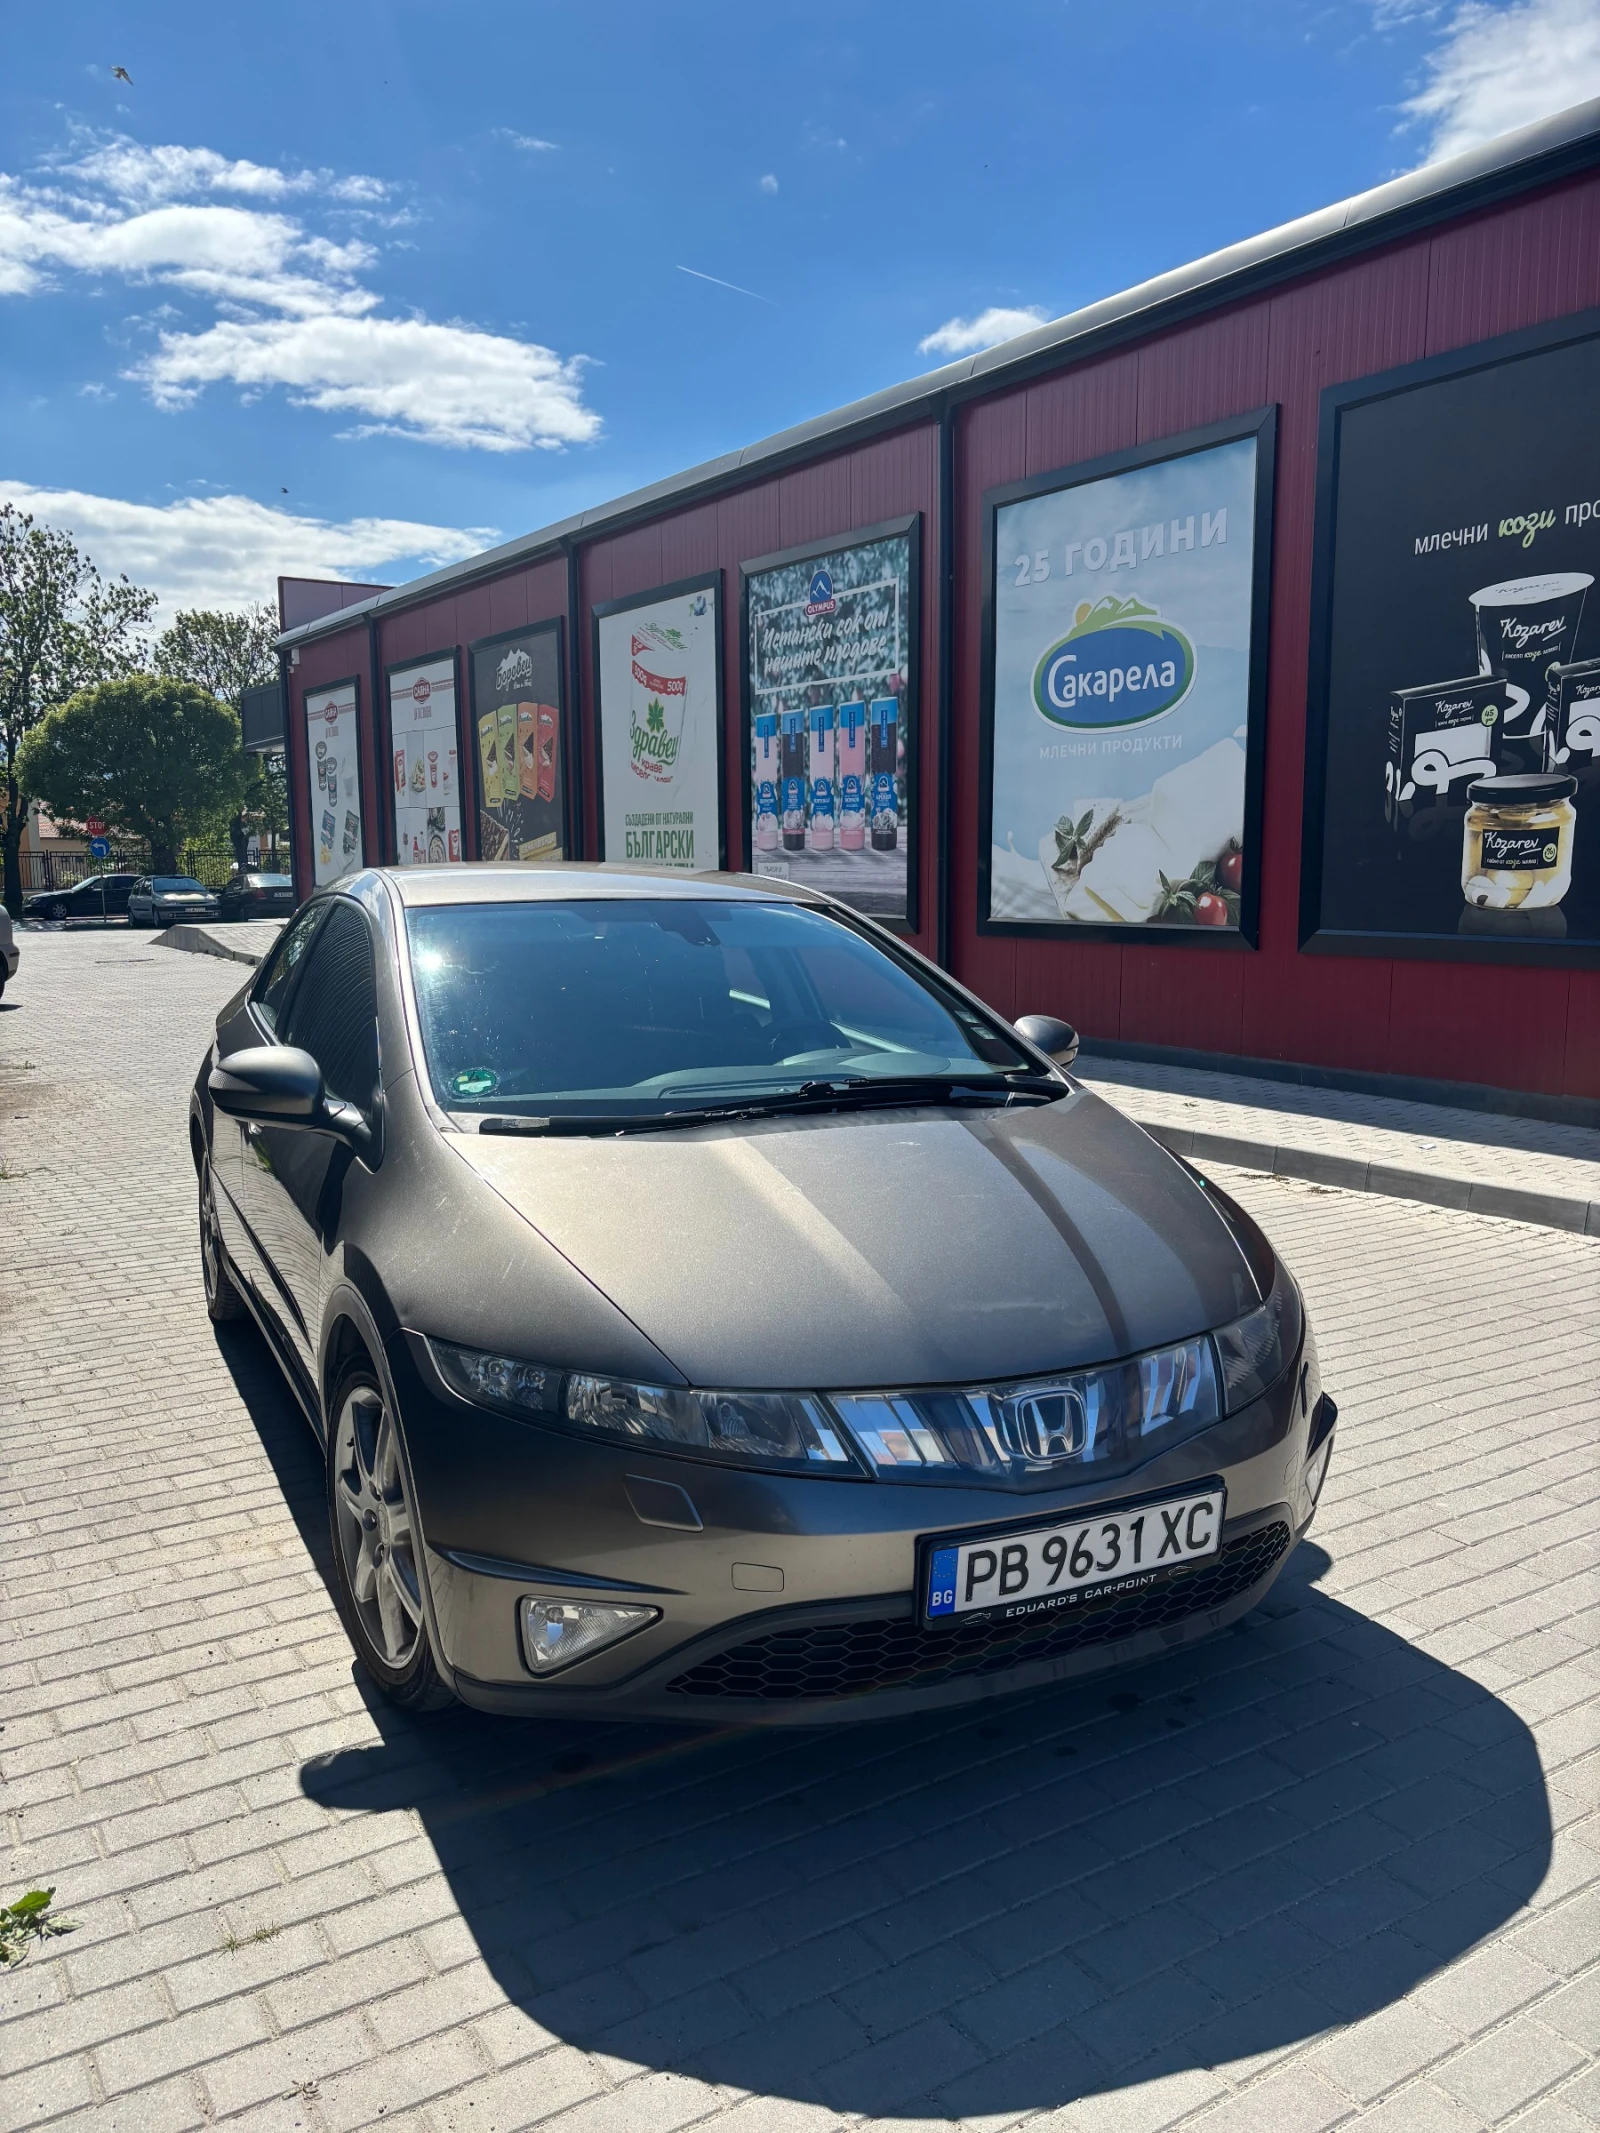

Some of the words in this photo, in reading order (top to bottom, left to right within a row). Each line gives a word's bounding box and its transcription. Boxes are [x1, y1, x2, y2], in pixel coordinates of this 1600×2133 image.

[1015, 549, 1050, 587] 25
[1065, 508, 1227, 576] ГОДИНИ
[1414, 523, 1489, 555] млечни
[1498, 509, 1556, 548] кози
[807, 600, 835, 614] OLYMPUS
[763, 619, 832, 650] Истински
[836, 615, 862, 637] сок
[864, 604, 889, 630] от
[1500, 616, 1567, 648] Kozarev
[764, 648, 821, 678] нашите
[824, 635, 887, 675] плодове
[496, 656, 532, 691] Боровец
[1047, 654, 1176, 708] Сакарела
[1435, 700, 1474, 718] Kozarev
[1484, 709, 1494, 717] 45
[630, 709, 680, 765] Здравец
[1040, 740, 1097, 760] МЛЕЧНИ
[1102, 735, 1182, 754] ПРОДУКТИ
[656, 812, 662, 826] ОТ
[662, 811, 694, 825] НАТУРАЛНИ
[625, 830, 694, 860] БЪЛГАРСКИ
[1484, 831, 1541, 858] Kozarev
[965, 1544, 1029, 1602] PB
[1042, 1516, 1146, 1586] 9631
[1157, 1501, 1213, 1558] XC
[931, 1589, 953, 1607] BG
[1005, 1593, 1078, 1618] EDUARD'S
[1084, 1573, 1157, 1599] CAR-POINT
